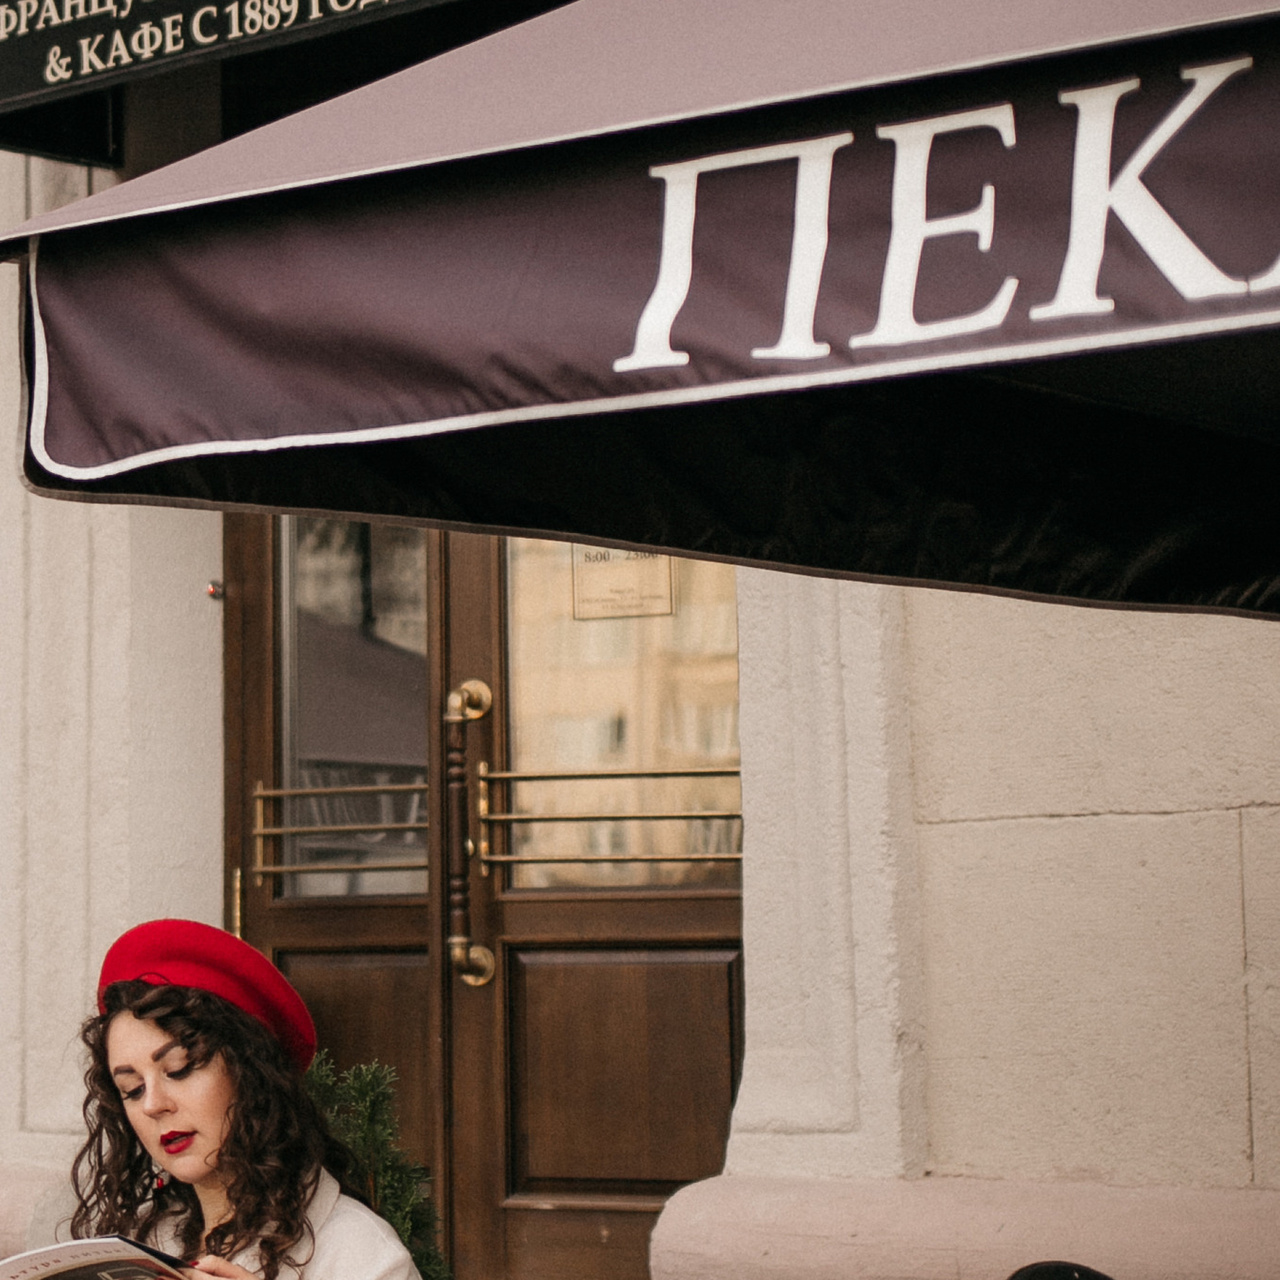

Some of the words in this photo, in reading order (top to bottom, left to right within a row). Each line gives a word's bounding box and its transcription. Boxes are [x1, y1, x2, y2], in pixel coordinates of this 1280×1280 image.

[44, 47, 73, 84] &
[79, 18, 184, 75] КАФЕ
[191, 7, 220, 44] С
[584, 550, 611, 563] 8:00
